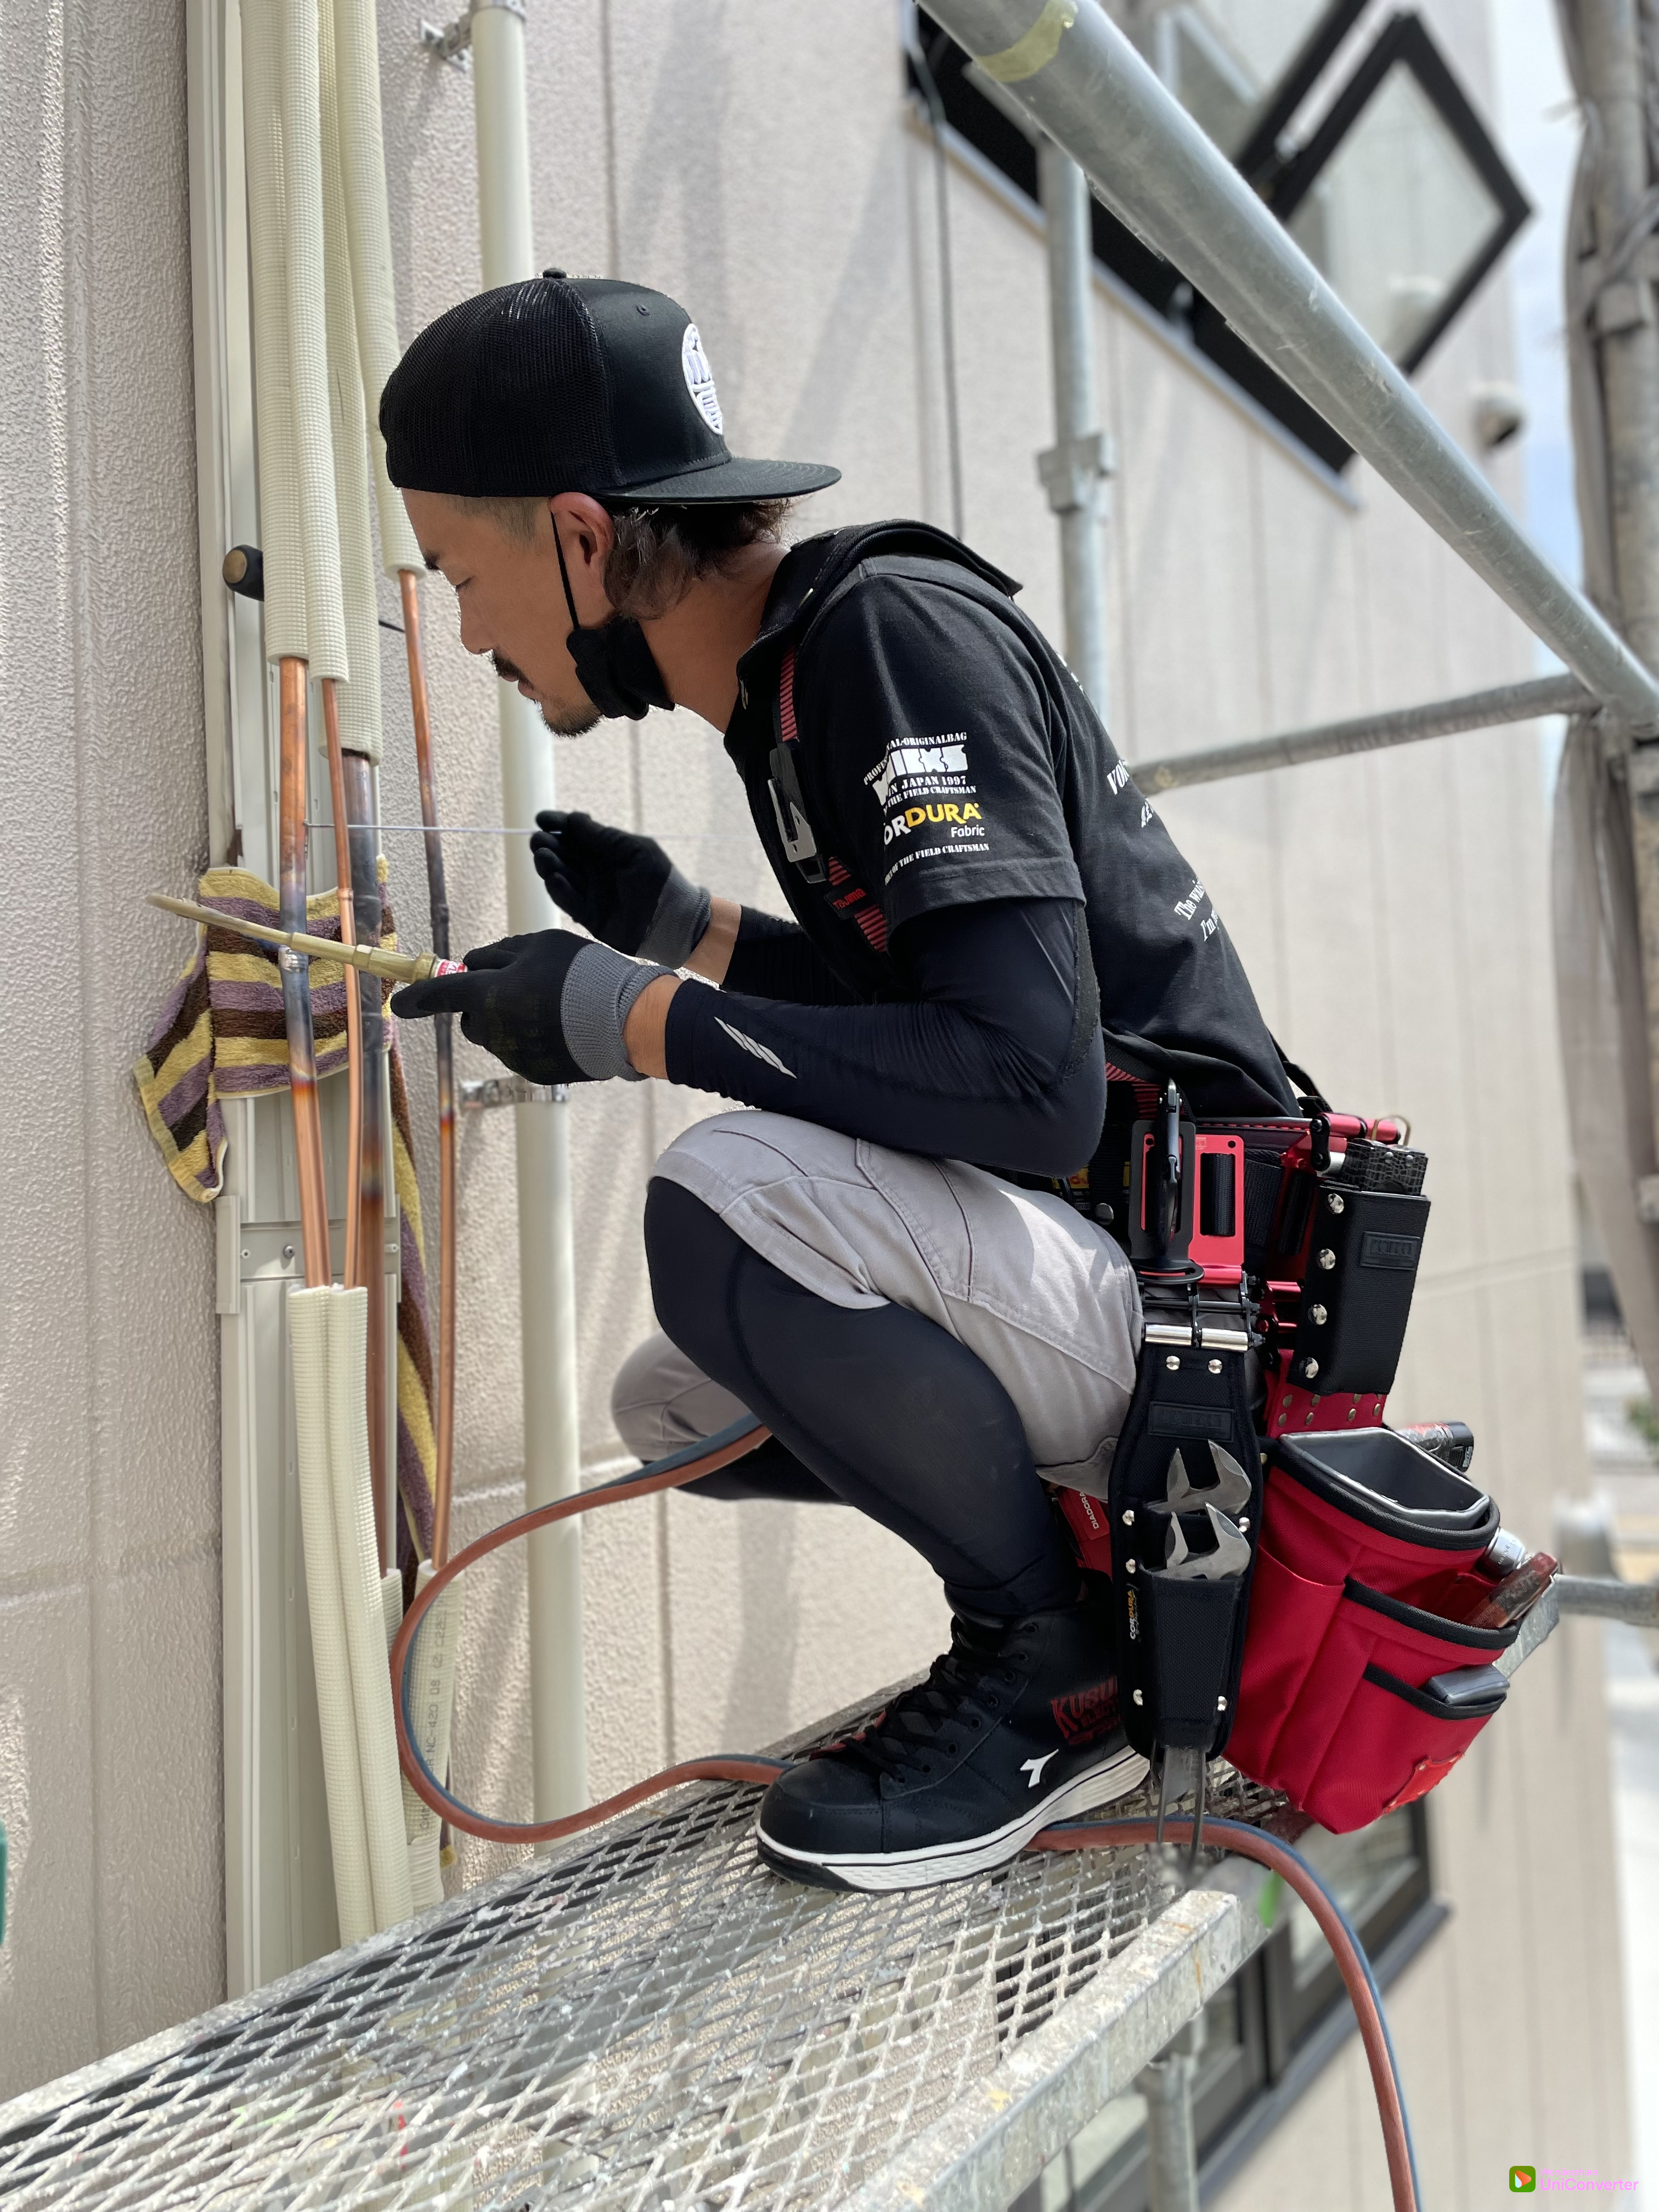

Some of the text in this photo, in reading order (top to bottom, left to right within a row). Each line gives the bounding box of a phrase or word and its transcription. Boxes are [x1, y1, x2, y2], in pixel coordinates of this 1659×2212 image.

[901, 776, 939, 790] JAPAN
[941, 775, 966, 786] 1997
[903, 787, 929, 800] FIELD
[930, 785, 977, 795] CRAFTSMAN
[884, 803, 982, 845] ORDURA
[951, 825, 985, 838] Fabric
[915, 847, 941, 859] FIELD
[942, 843, 990, 854] CRAFTSMAN
[1173, 899, 1197, 921] The
[1078, 1490, 1099, 1530] DIADORA
